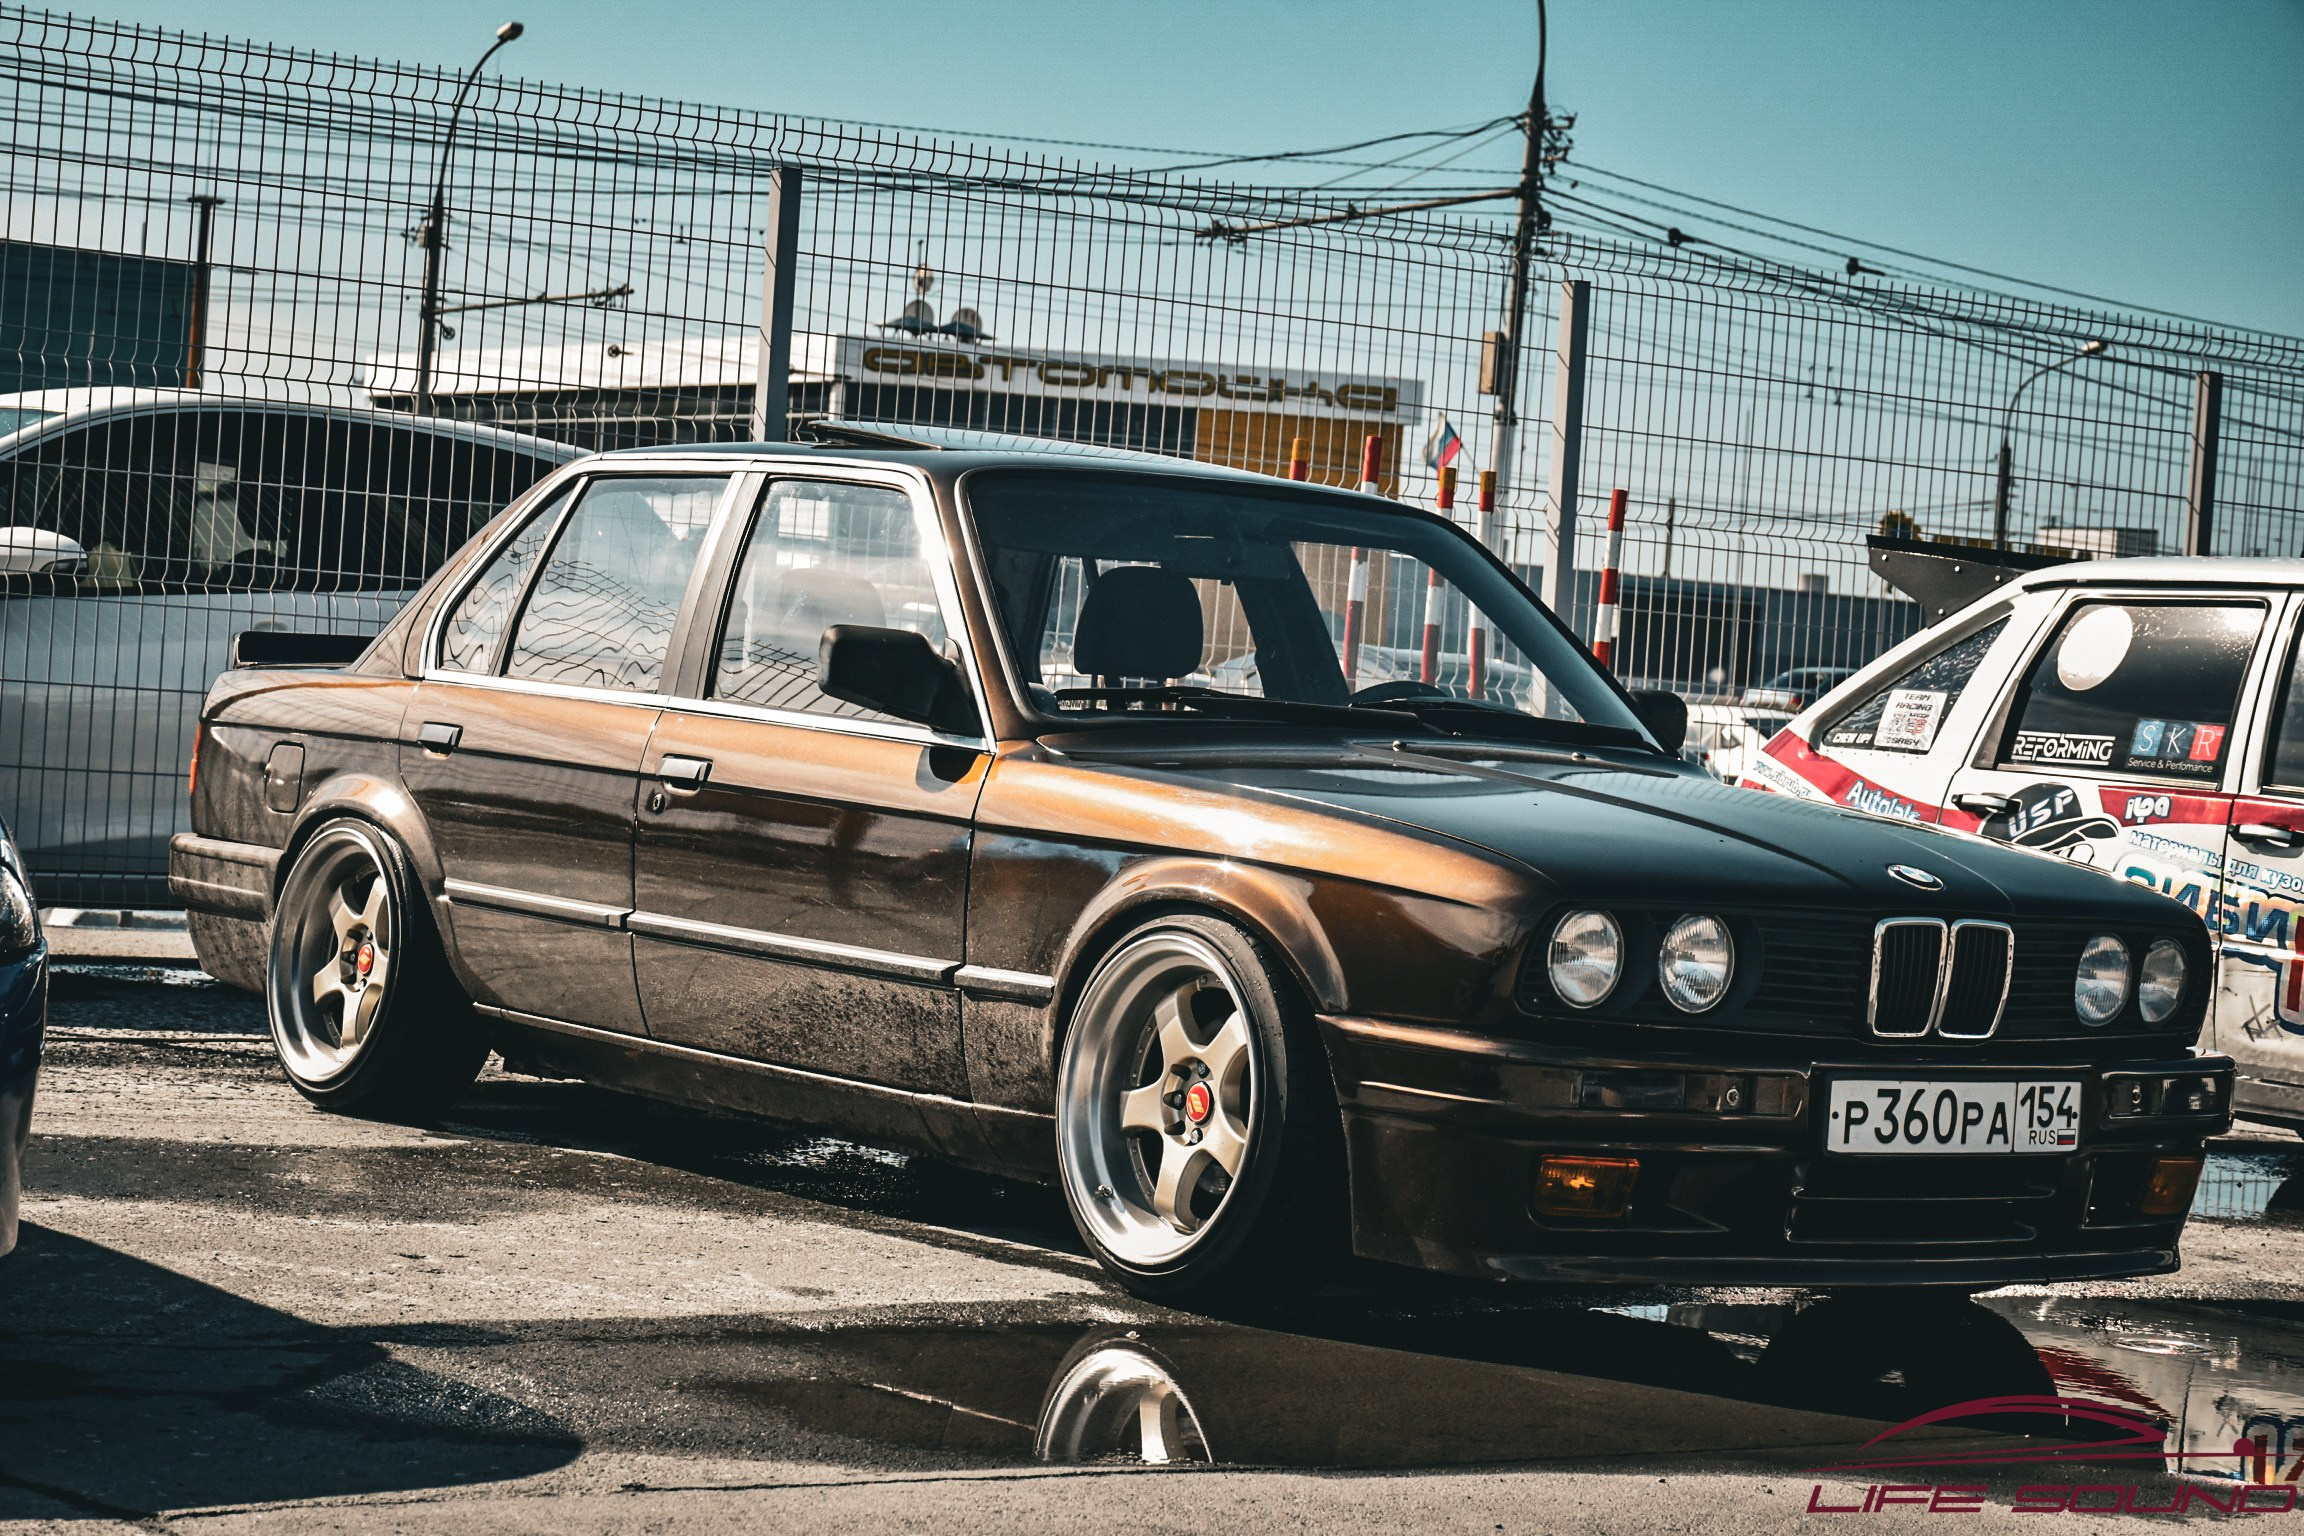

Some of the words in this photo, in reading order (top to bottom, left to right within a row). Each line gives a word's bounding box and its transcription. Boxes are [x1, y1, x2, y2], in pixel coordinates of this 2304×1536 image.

[1904, 692, 1931, 702] TEAM
[1895, 702, 1933, 712] RACING
[2127, 757, 2156, 769] Service
[2157, 760, 2164, 769] &
[2128, 829, 2224, 868] материалы
[2223, 857, 2259, 878] для
[2259, 867, 2304, 891] кузо
[1843, 1087, 2009, 1145] Р360РА
[2019, 1085, 2073, 1129] 154
[2028, 1129, 2056, 1146] RUS
